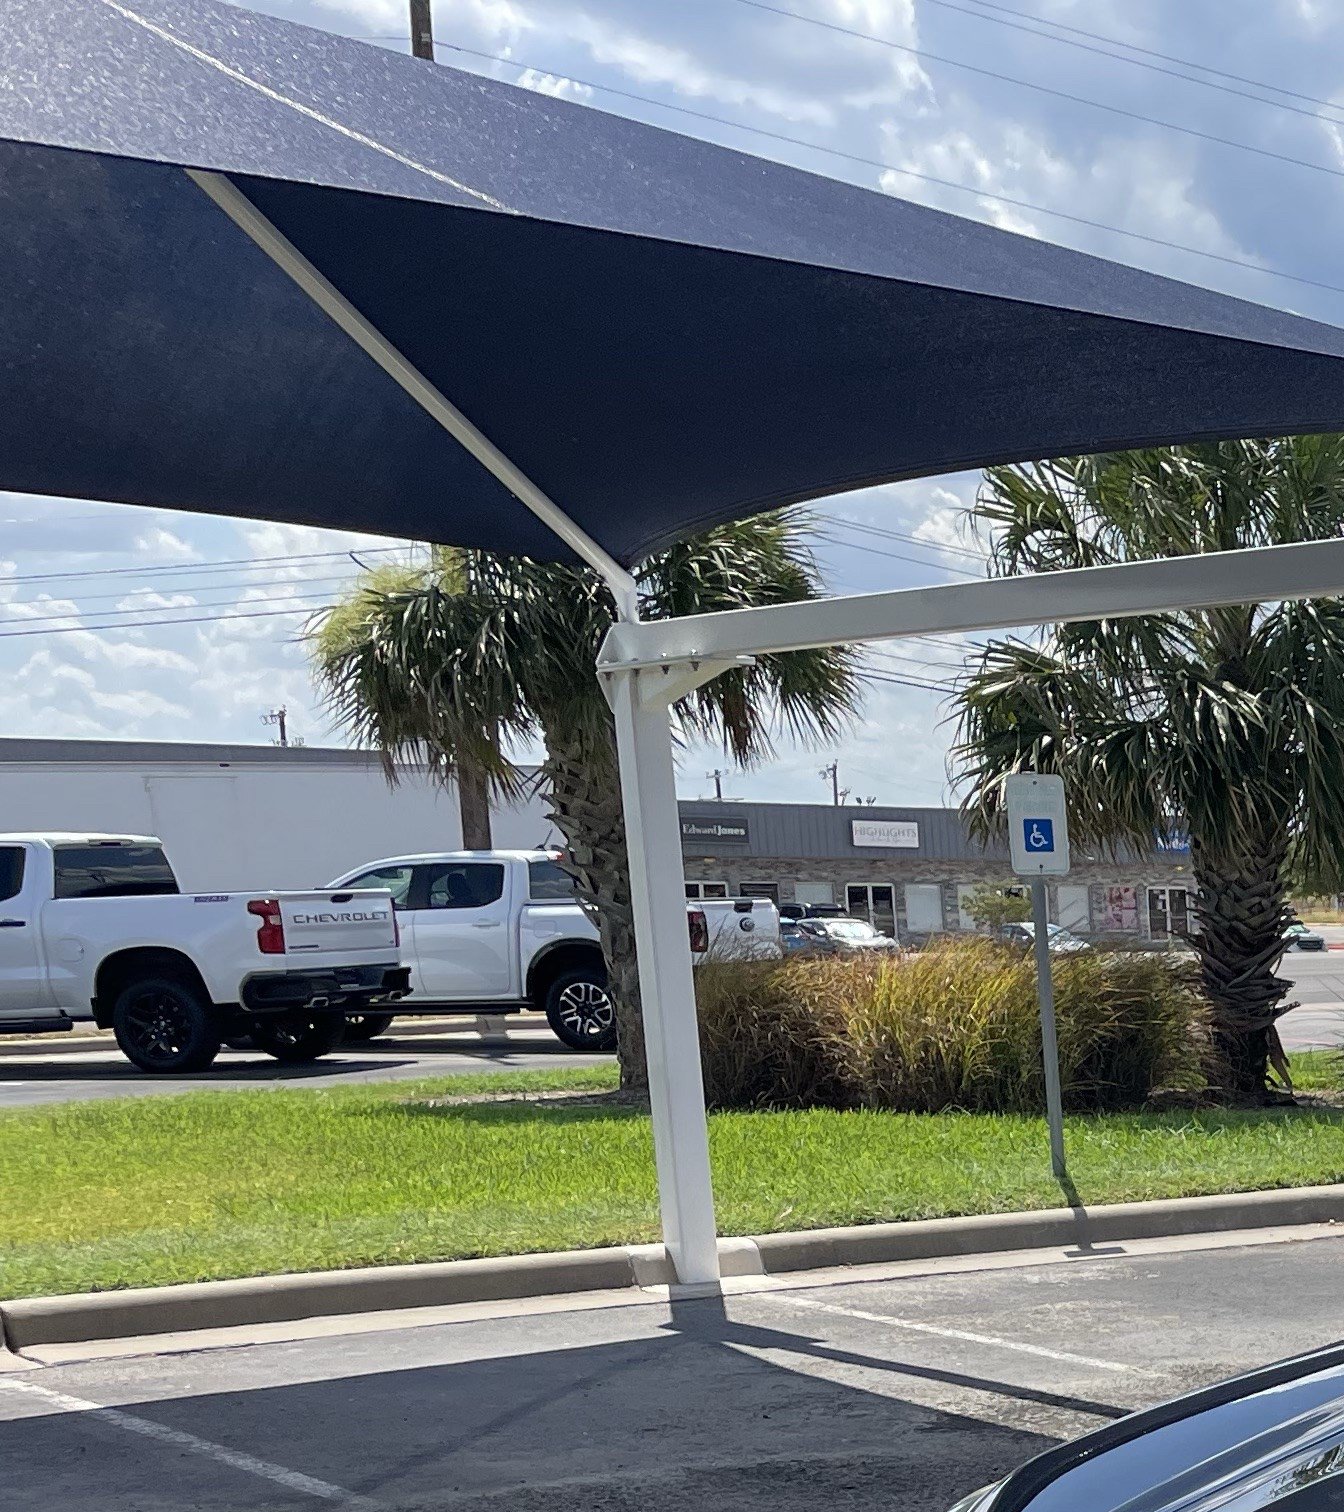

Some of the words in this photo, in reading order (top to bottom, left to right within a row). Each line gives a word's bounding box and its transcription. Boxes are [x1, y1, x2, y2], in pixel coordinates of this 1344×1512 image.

[682, 823, 717, 834] Edward
[717, 825, 746, 836] Jones
[854, 824, 917, 838] HIGHLIGHTS
[293, 911, 388, 924] CHEVROLET
